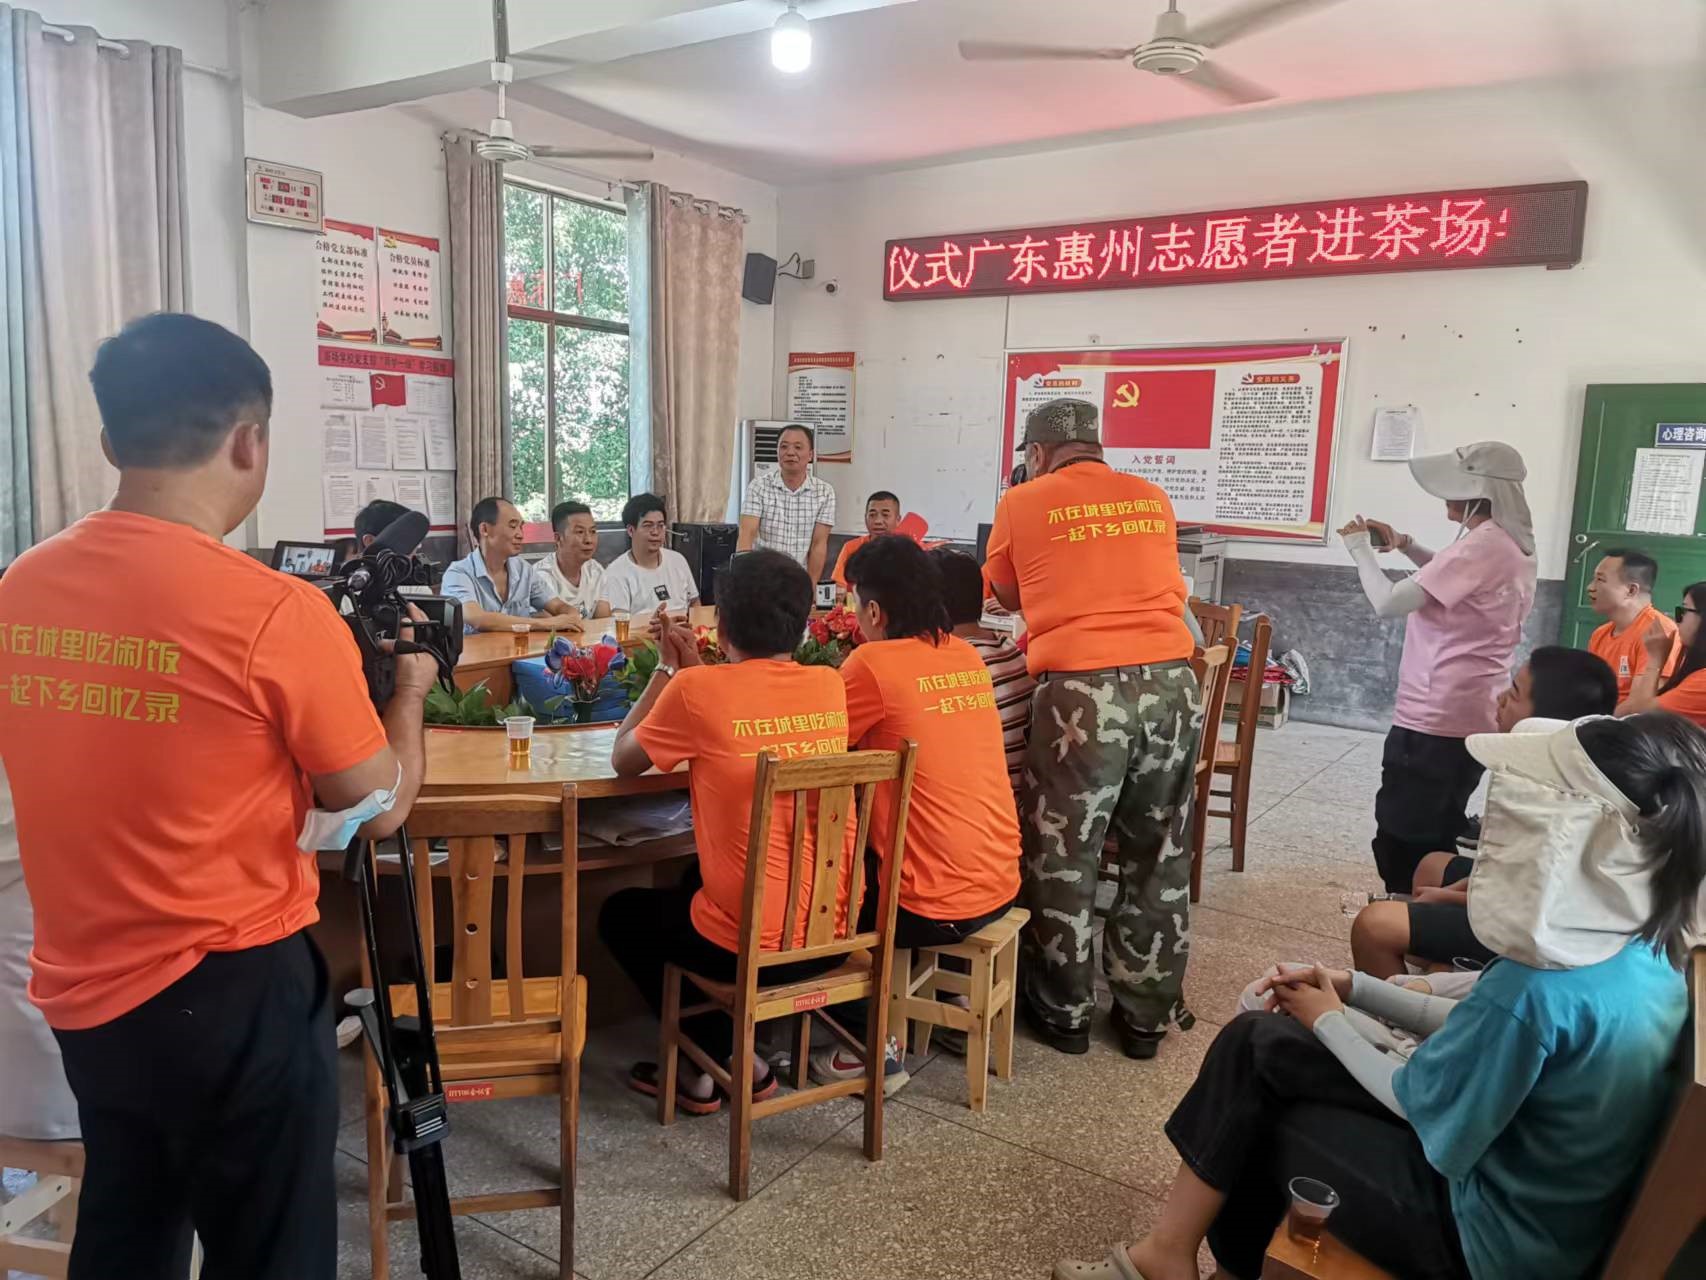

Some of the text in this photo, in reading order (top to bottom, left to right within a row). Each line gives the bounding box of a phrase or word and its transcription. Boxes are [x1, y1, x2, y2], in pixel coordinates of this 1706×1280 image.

[315, 239, 369, 258] 合格党支部标准
[389, 253, 431, 268] 合格党员标准
[1662, 427, 1706, 441] 心理咨询
[1131, 455, 1176, 465] 入党誓词
[1047, 499, 1164, 525] 不在城里吃闲饭
[1050, 519, 1168, 542] 一起下乡回忆录
